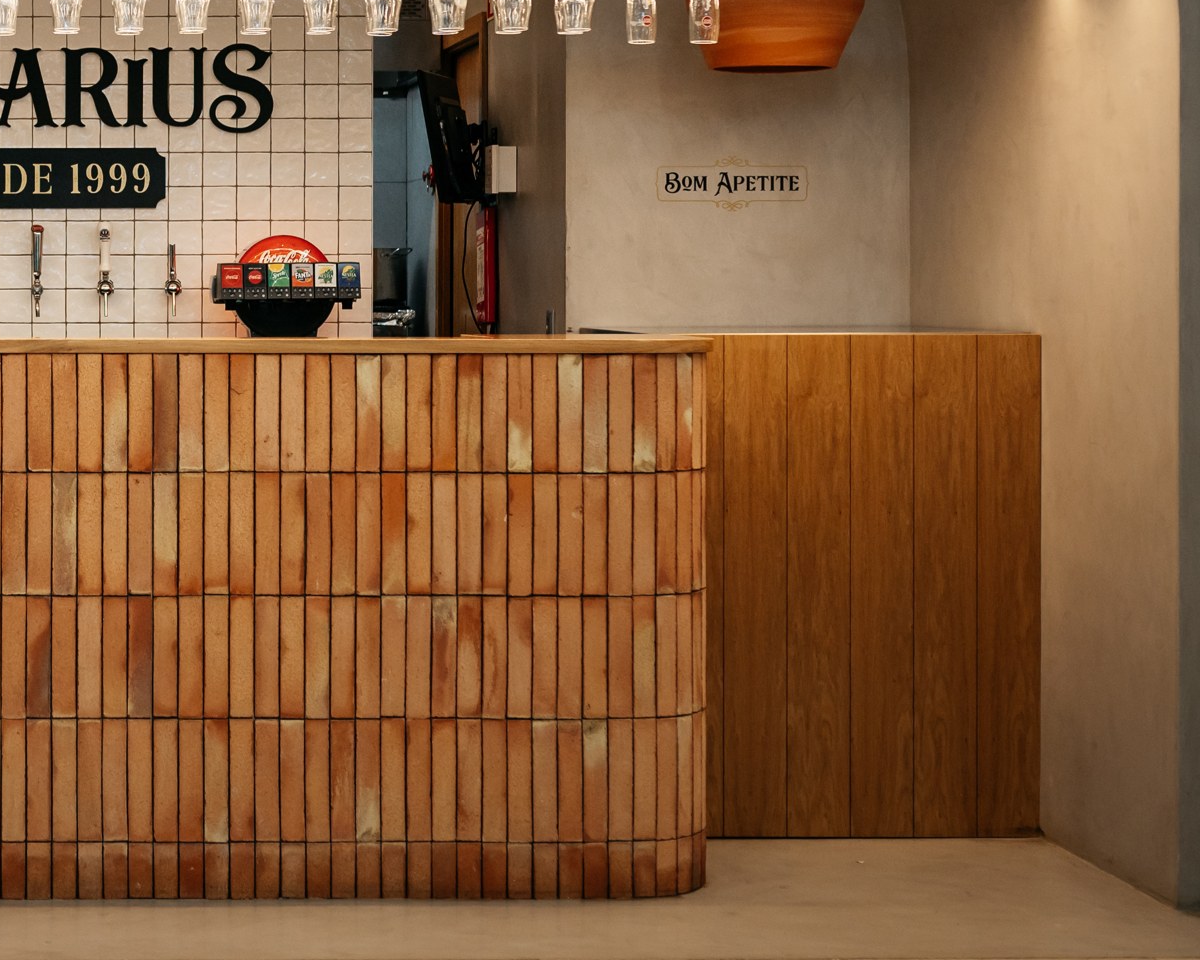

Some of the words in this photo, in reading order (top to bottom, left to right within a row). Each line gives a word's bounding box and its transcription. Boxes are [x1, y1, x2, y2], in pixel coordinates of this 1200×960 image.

[70, 163, 151, 195] 1999
[664, 171, 707, 194] BOM
[714, 171, 800, 196] APETITE
